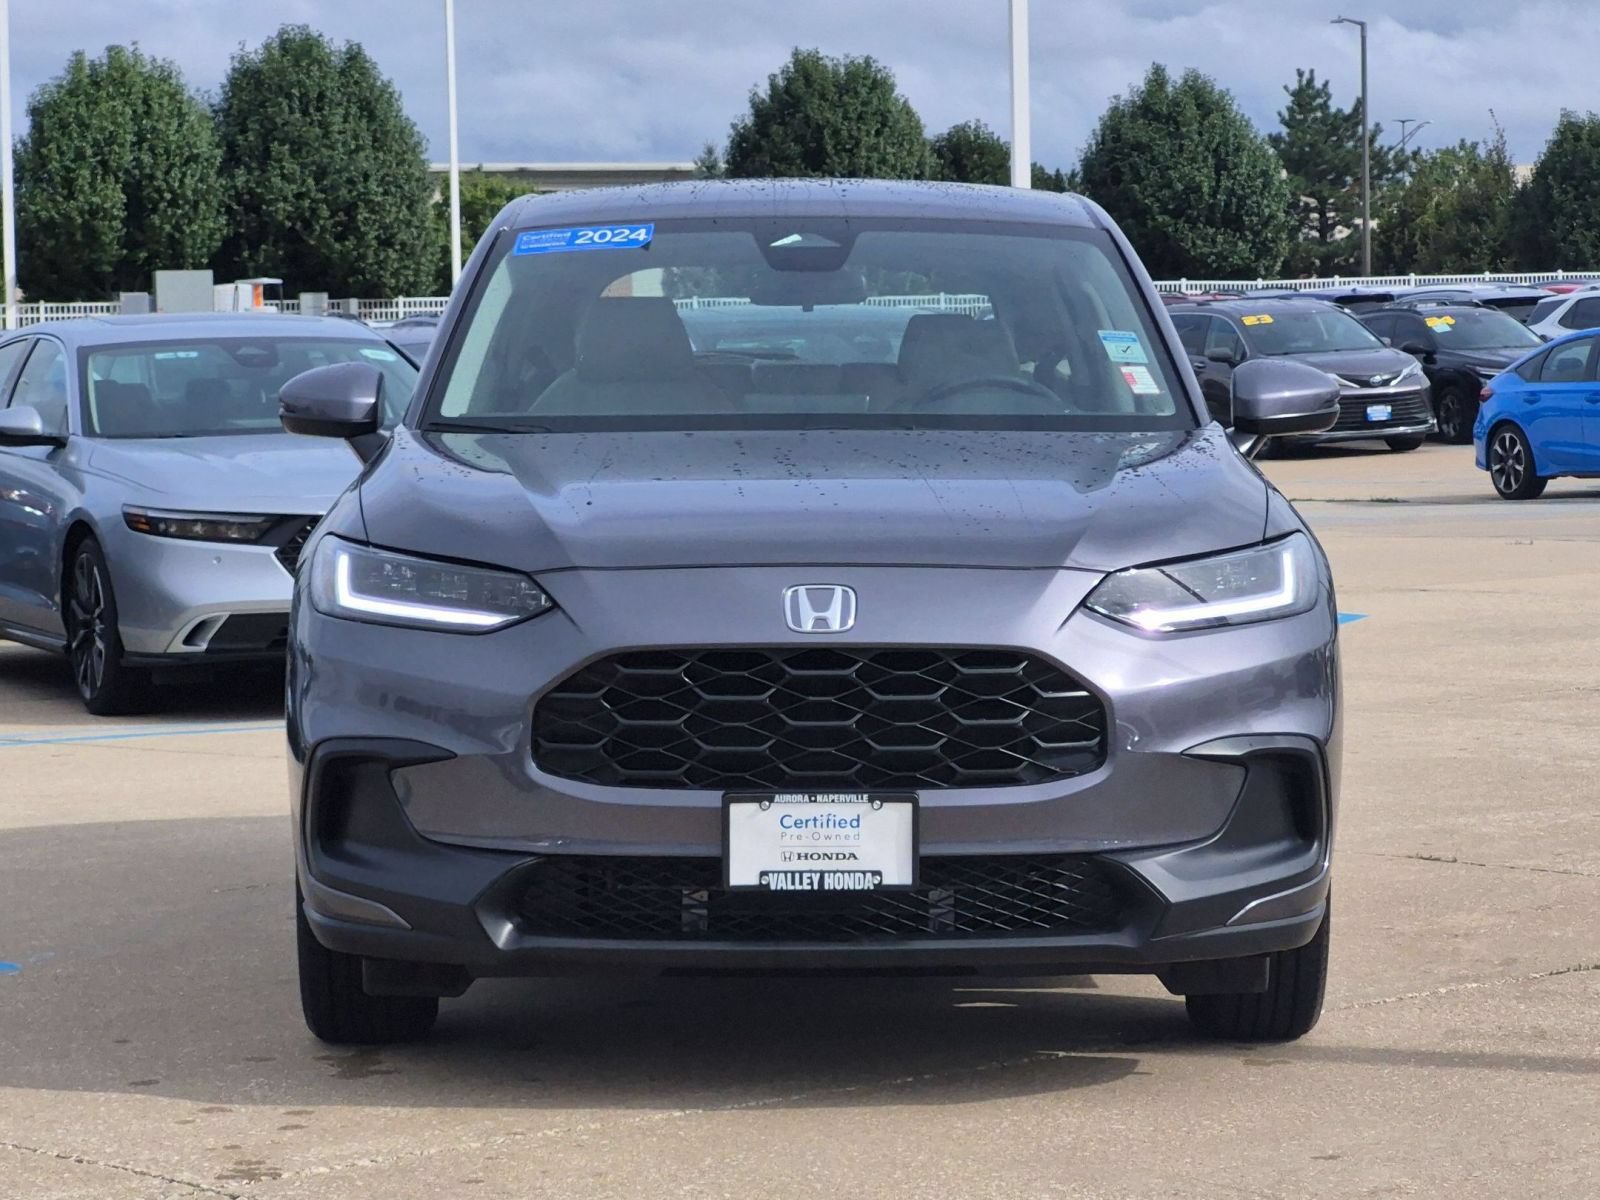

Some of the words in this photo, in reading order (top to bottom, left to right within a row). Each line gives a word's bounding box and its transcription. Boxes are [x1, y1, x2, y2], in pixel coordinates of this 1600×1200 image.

[575, 229, 648, 244] 2024
[774, 794, 809, 803] AURORA
[816, 794, 869, 803] NAPERVILLE
[780, 813, 860, 829] Certified
[780, 832, 860, 841] Pre-Owned
[797, 853, 858, 861] HONDA
[768, 873, 820, 890] VALLEY
[824, 873, 874, 890] HONDA
